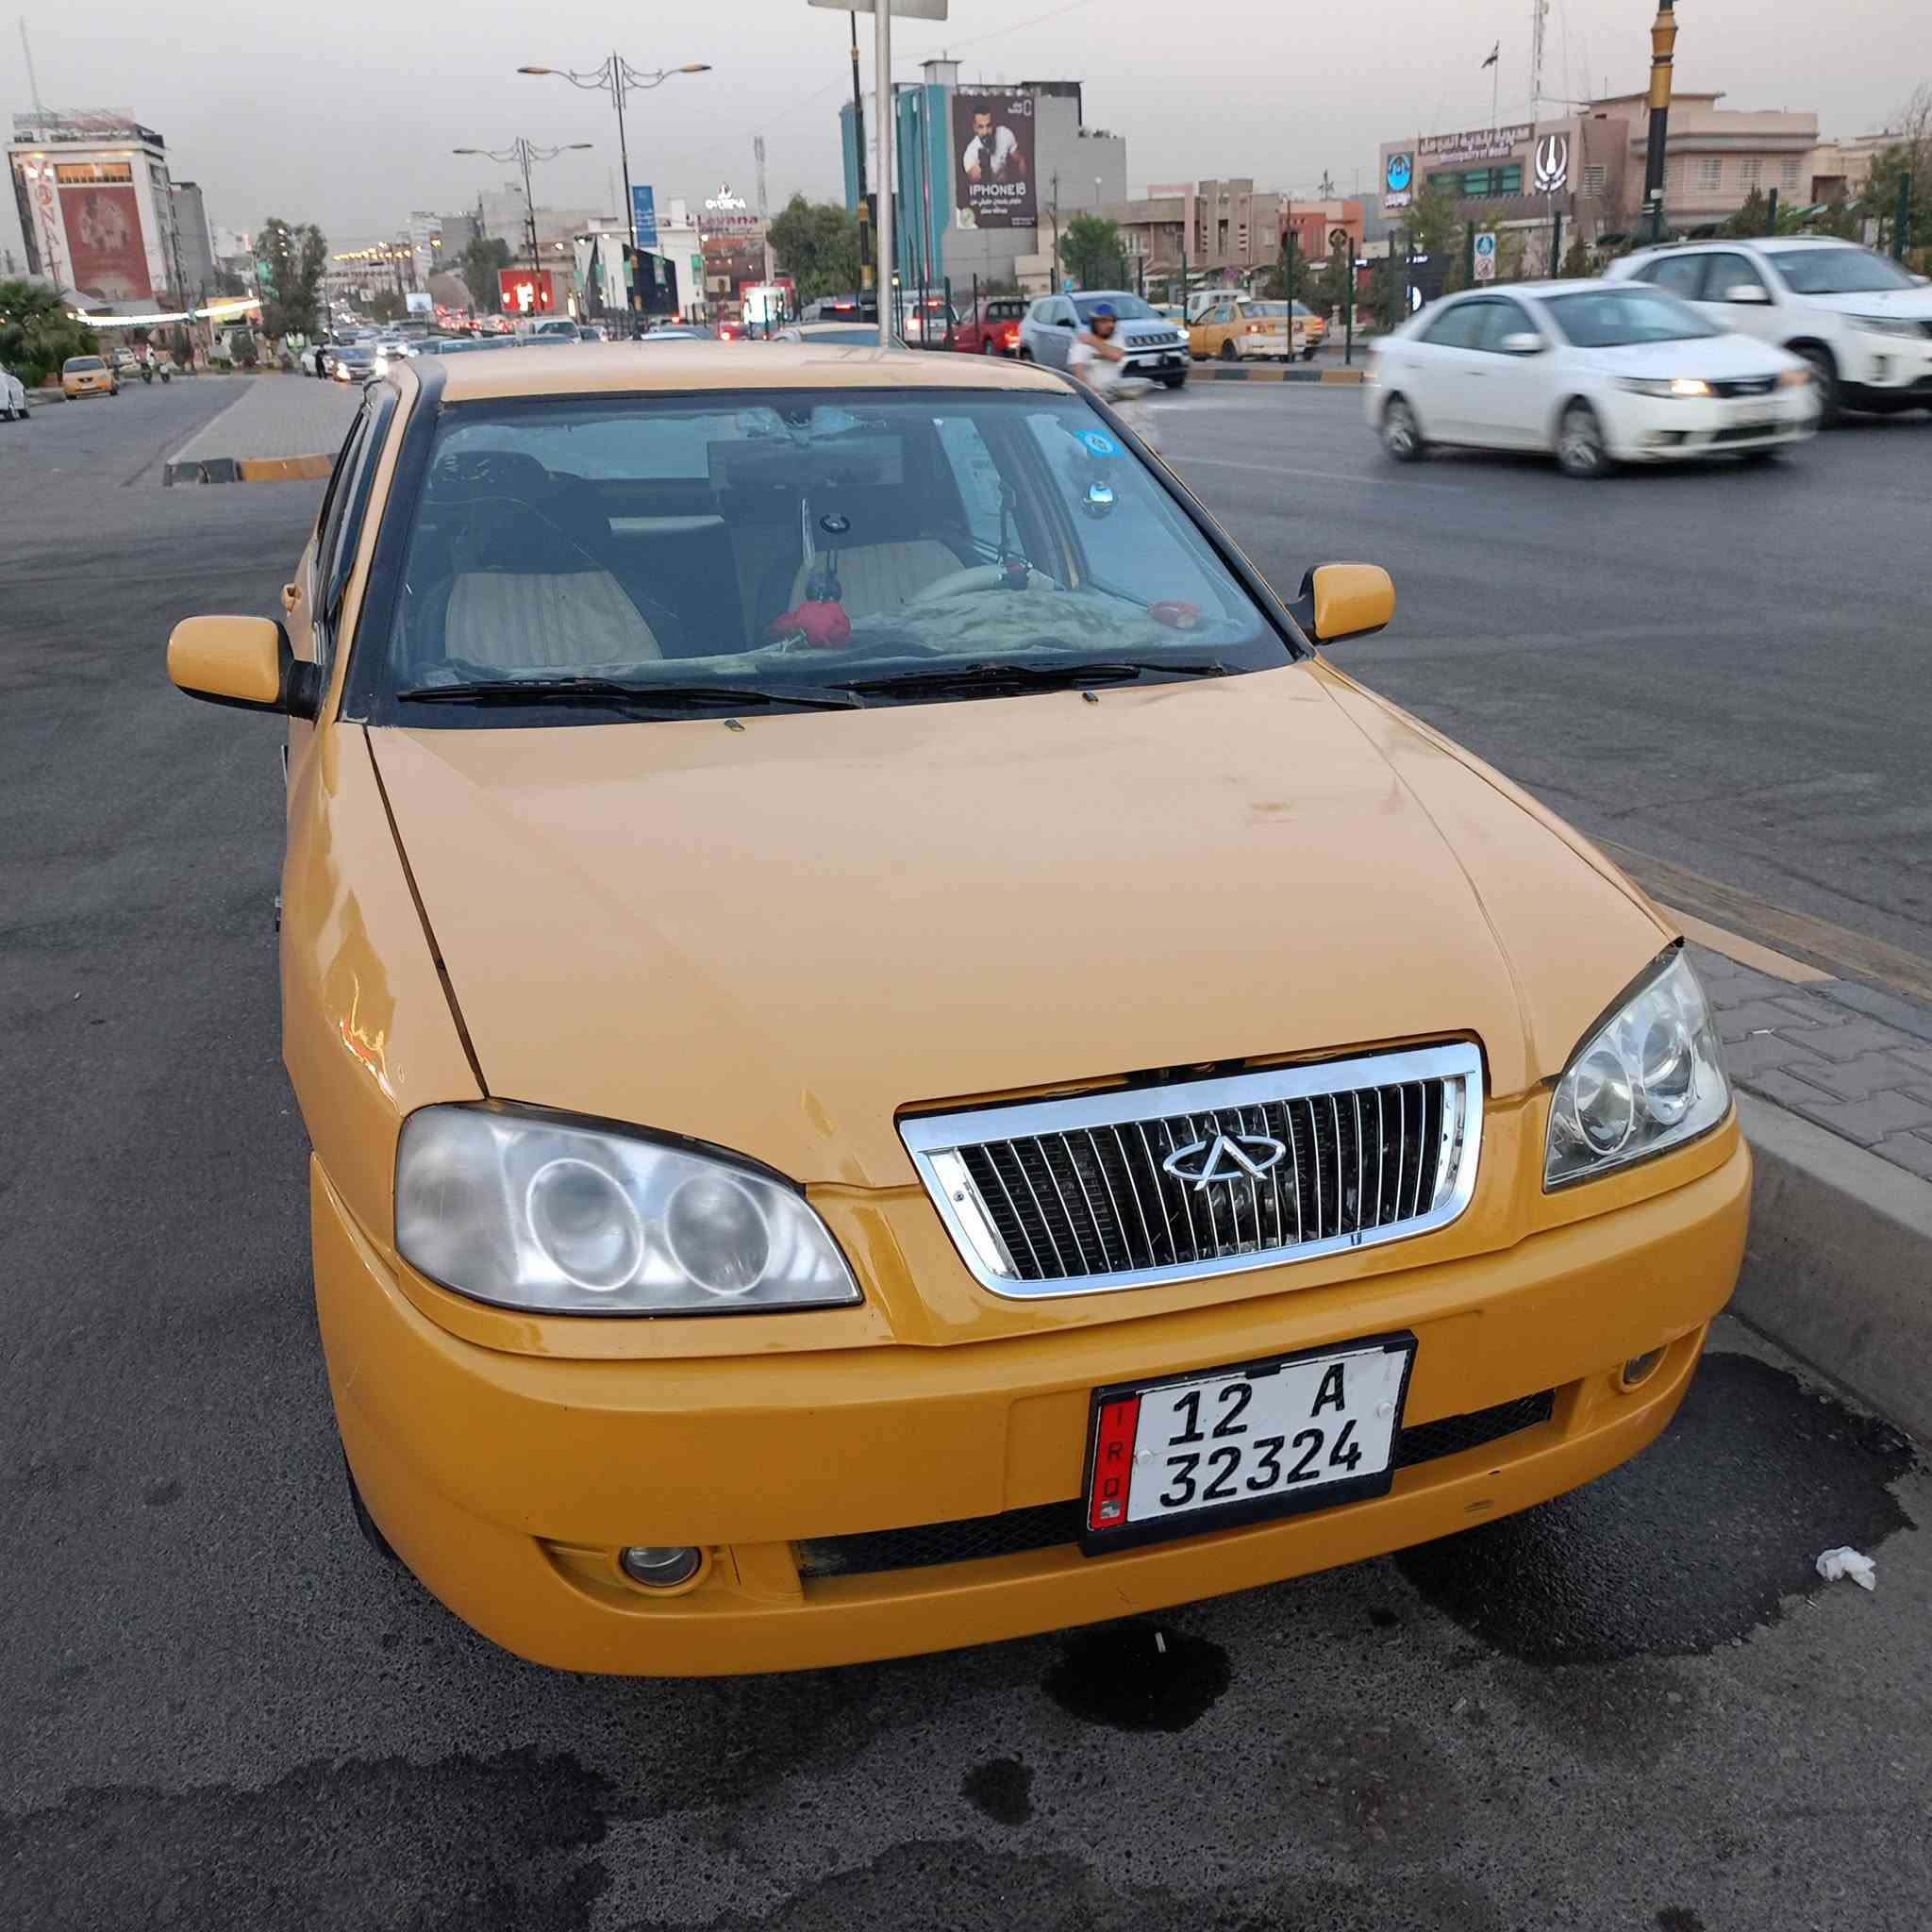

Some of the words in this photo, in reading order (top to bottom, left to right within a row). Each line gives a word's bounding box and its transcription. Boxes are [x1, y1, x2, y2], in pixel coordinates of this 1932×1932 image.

[1168, 1382, 1253, 1446] 12
[1309, 1362, 1346, 1418] A
[1159, 1418, 1363, 1508] 32324
